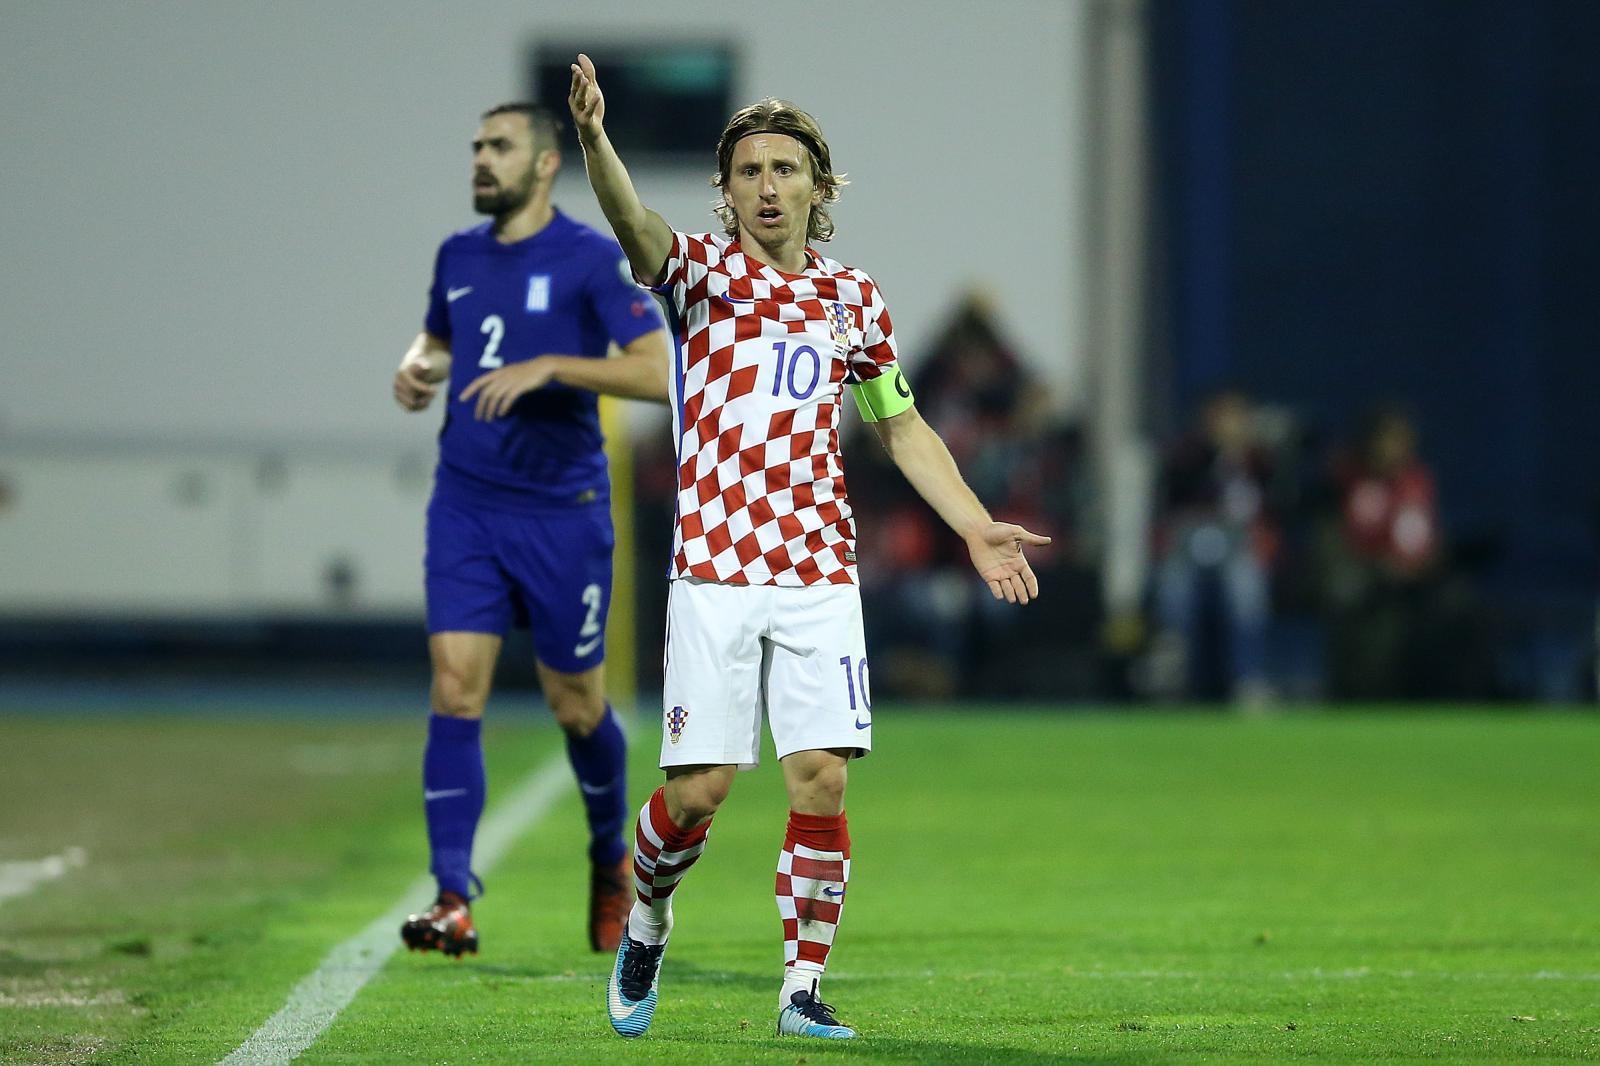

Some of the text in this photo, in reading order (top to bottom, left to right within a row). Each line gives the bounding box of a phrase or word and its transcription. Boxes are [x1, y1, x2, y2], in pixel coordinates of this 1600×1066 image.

[479, 315, 504, 368] 2
[772, 341, 820, 400] 10
[580, 584, 601, 637] 2
